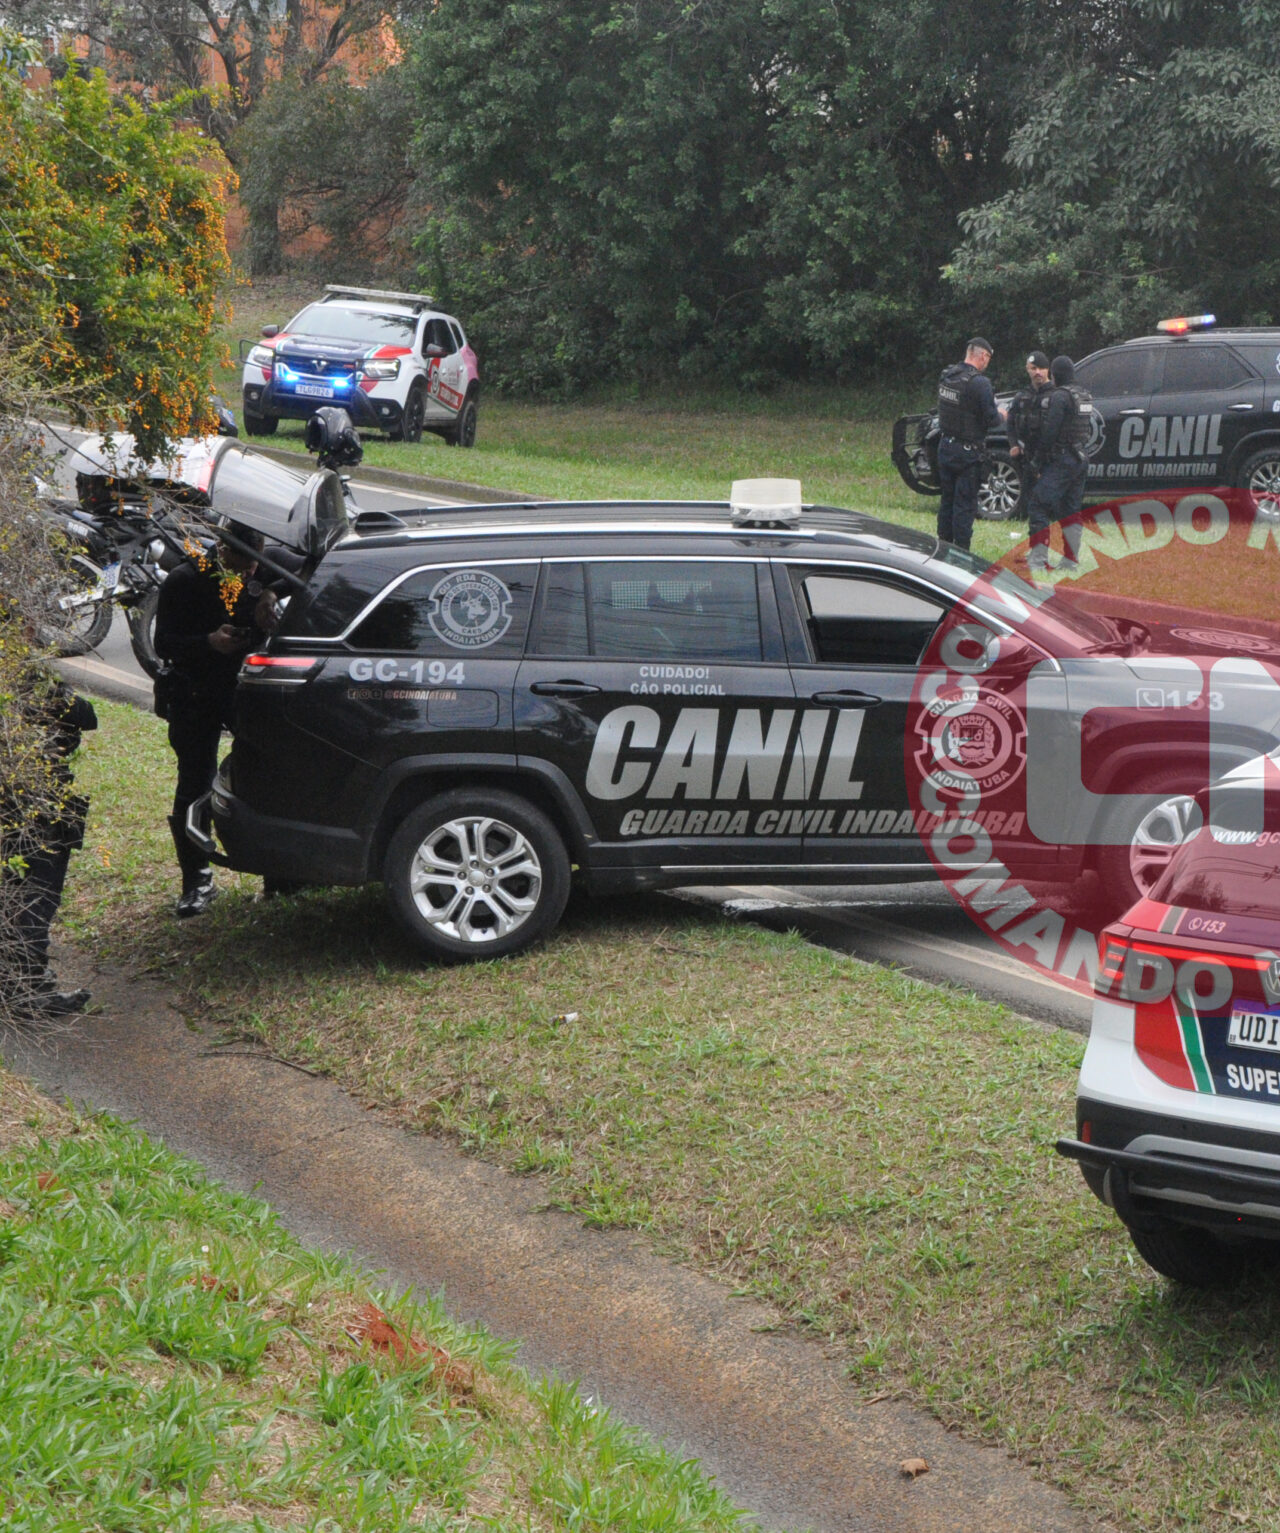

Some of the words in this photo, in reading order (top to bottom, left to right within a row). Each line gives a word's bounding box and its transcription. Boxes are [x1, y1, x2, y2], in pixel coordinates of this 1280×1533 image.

[1118, 414, 1224, 459] CANIL
[1107, 464, 1139, 477] CIVIL
[1142, 463, 1217, 477] INDAIATUBA
[439, 574, 477, 595] GURDA
[480, 576, 502, 595] CIVIL
[441, 627, 501, 645] INDAIATUBA
[348, 657, 466, 685] GC-194
[639, 666, 710, 680] CUIDADO!
[630, 680, 660, 695] CÃO
[663, 684, 727, 696] POLICIAL
[929, 692, 979, 719] GUARDA
[986, 695, 1014, 720] CIVIL
[1166, 690, 1226, 711] 153
[585, 705, 866, 801] CANIL
[929, 768, 1011, 792] INDAIATUBA
[619, 809, 750, 835] GUARDA
[753, 809, 833, 835] CIVIL
[840, 811, 1028, 836] INDAIATUBA
[1200, 919, 1226, 934] 153
